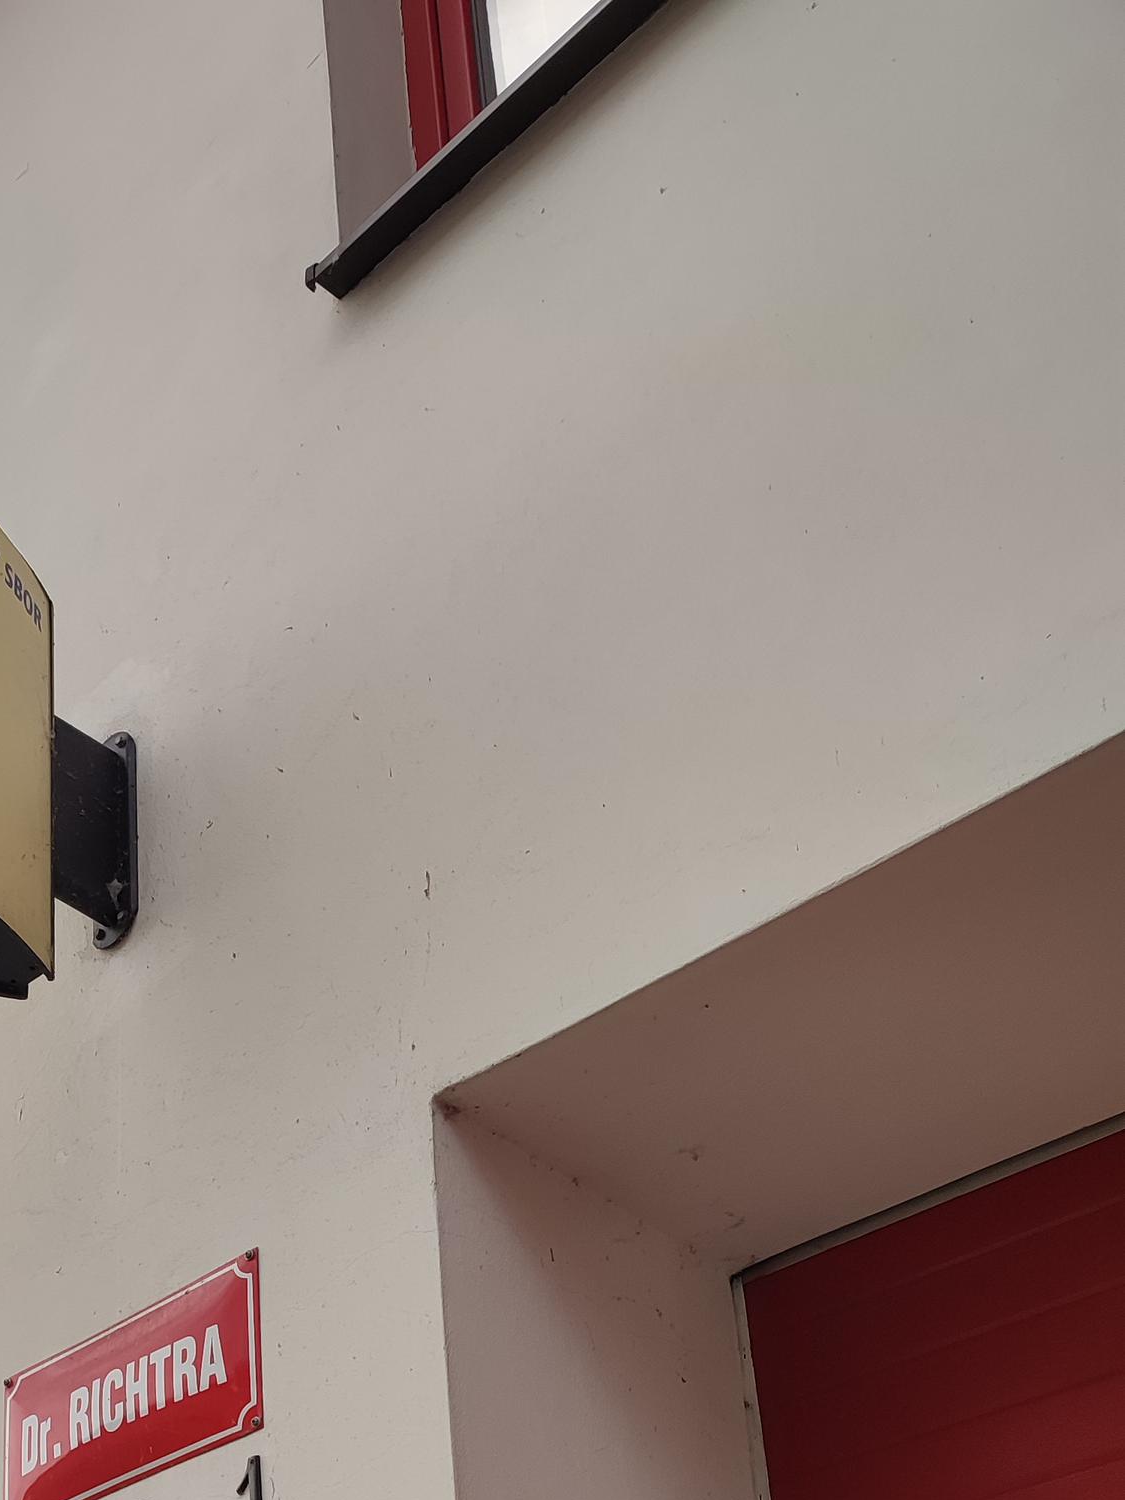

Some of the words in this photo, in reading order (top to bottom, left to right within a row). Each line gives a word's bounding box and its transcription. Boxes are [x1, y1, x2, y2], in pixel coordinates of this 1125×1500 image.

[4, 562, 43, 633] SBOR
[21, 1413, 63, 1477] Dr.
[69, 1324, 228, 1451] RICHTRA
